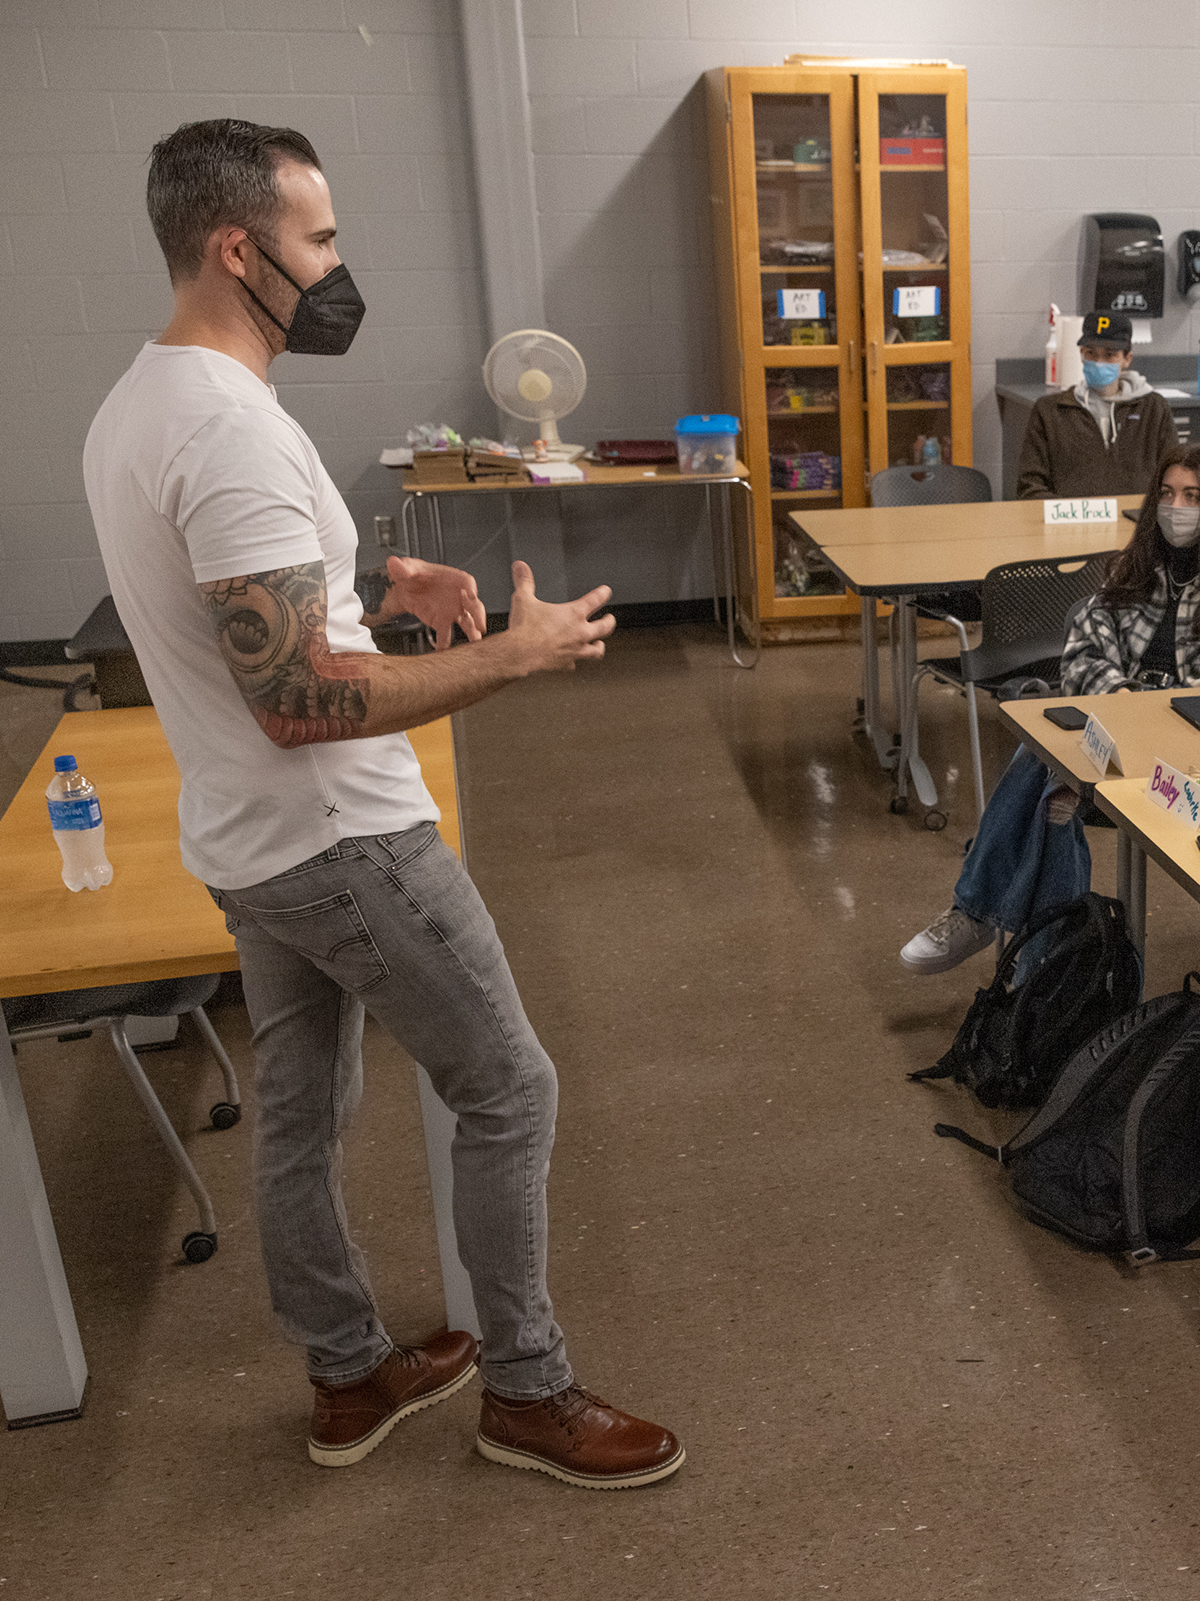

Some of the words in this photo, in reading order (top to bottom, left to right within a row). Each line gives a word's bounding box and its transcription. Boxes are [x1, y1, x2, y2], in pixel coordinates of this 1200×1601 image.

[1097, 316, 1110, 334] P
[1051, 502, 1078, 520] Jack
[1151, 764, 1181, 810] Bailey
